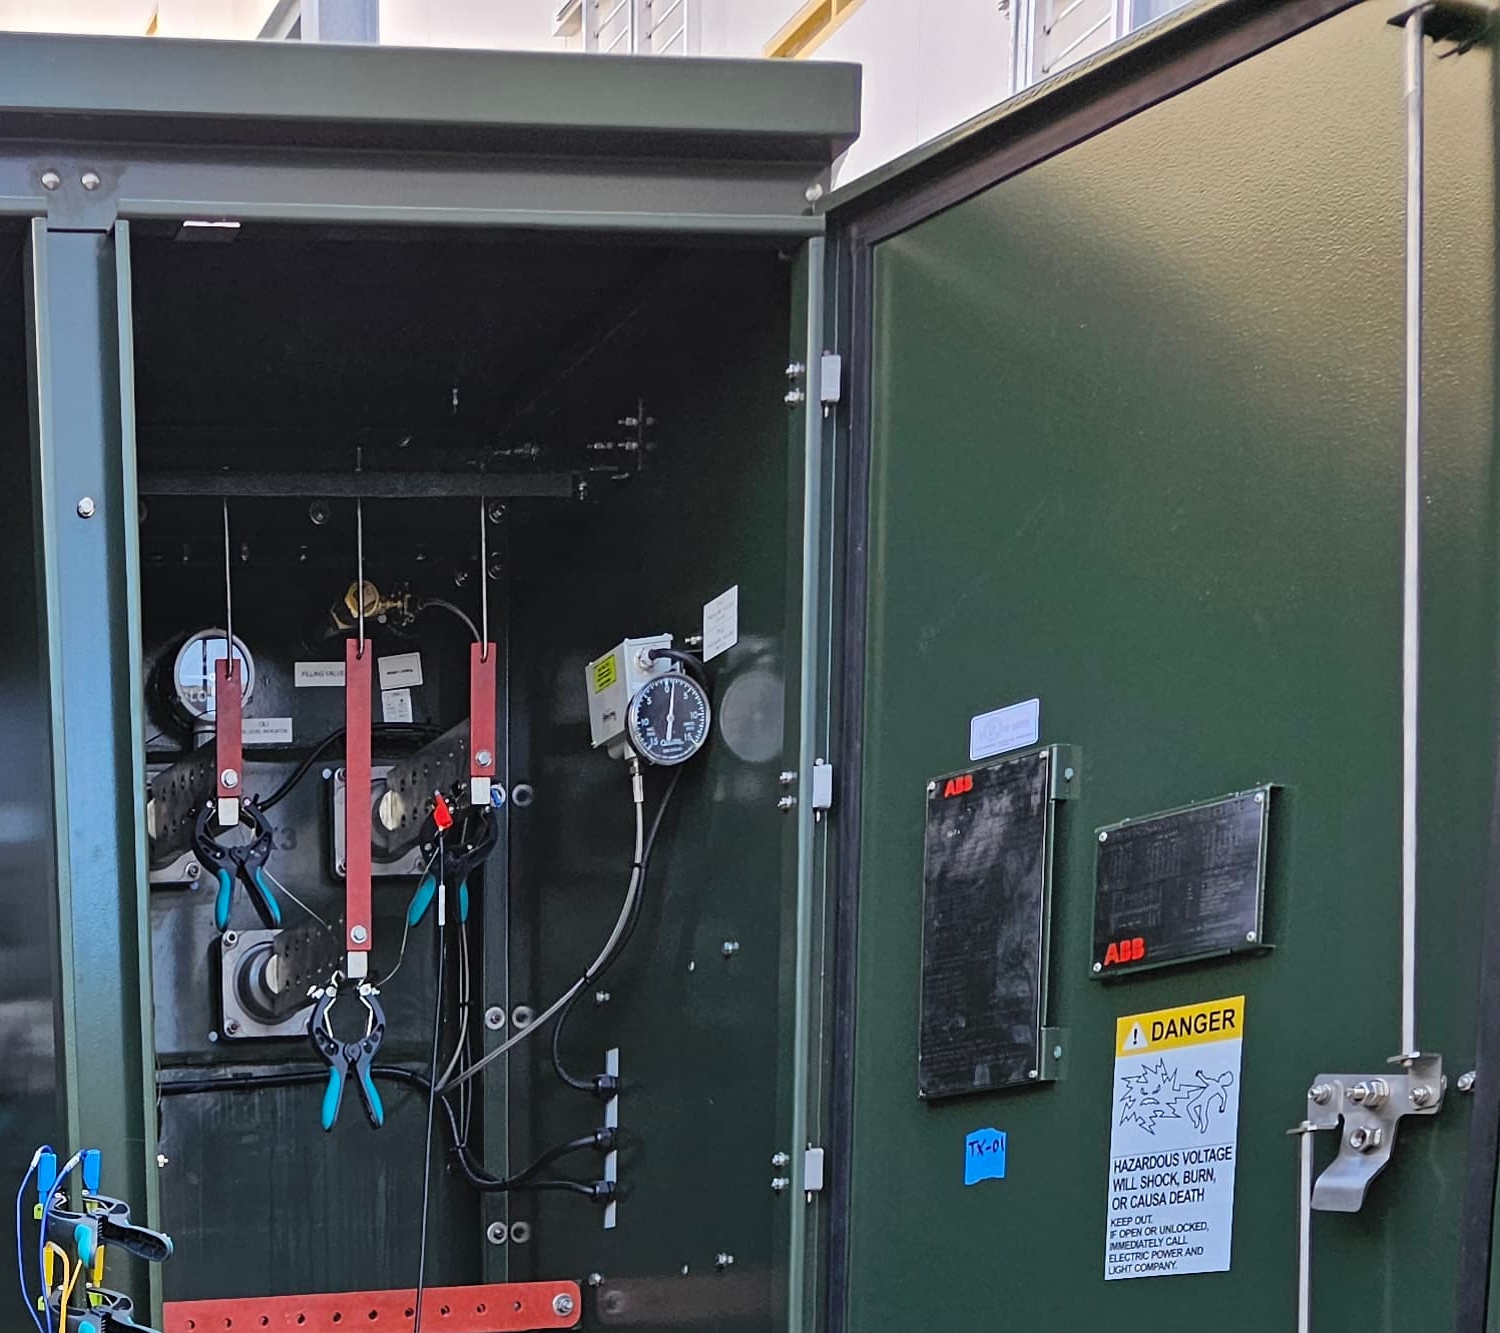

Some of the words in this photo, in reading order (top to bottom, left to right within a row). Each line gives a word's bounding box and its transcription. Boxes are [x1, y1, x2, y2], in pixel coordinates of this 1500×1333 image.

[944, 774, 973, 799] ABB
[1104, 937, 1145, 966] ABB
[1151, 1008, 1236, 1042] DANGER
[968, 1136, 1005, 1156] TX-01
[1114, 1152, 1180, 1173] HAZARDOUS
[1183, 1146, 1233, 1165] VOLTAGE
[1113, 1178, 1137, 1192] WILL
[1140, 1172, 1180, 1189] SHOCK,
[1183, 1168, 1216, 1184] BURN,
[1112, 1197, 1127, 1210] OR
[1130, 1192, 1166, 1209] CAUSA
[1170, 1188, 1204, 1204] DEATH
[1110, 1230, 1117, 1239] IF
[1119, 1228, 1142, 1238] OPEN
[1144, 1226, 1157, 1236] OR
[1160, 1221, 1209, 1235] UNLOCKED,
[1111, 1217, 1132, 1227] KEEP
[1135, 1215, 1153, 1225] OUT.
[1109, 1238, 1164, 1251] IMMEDIATELY
[1166, 1236, 1188, 1246] CALL
[1109, 1251, 1149, 1263] ELECTRIC
[1151, 1249, 1183, 1259] POWER
[1184, 1246, 1203, 1257] AND
[1109, 1264, 1132, 1275] LIGHT
[1134, 1261, 1177, 1272] COMPANY.
